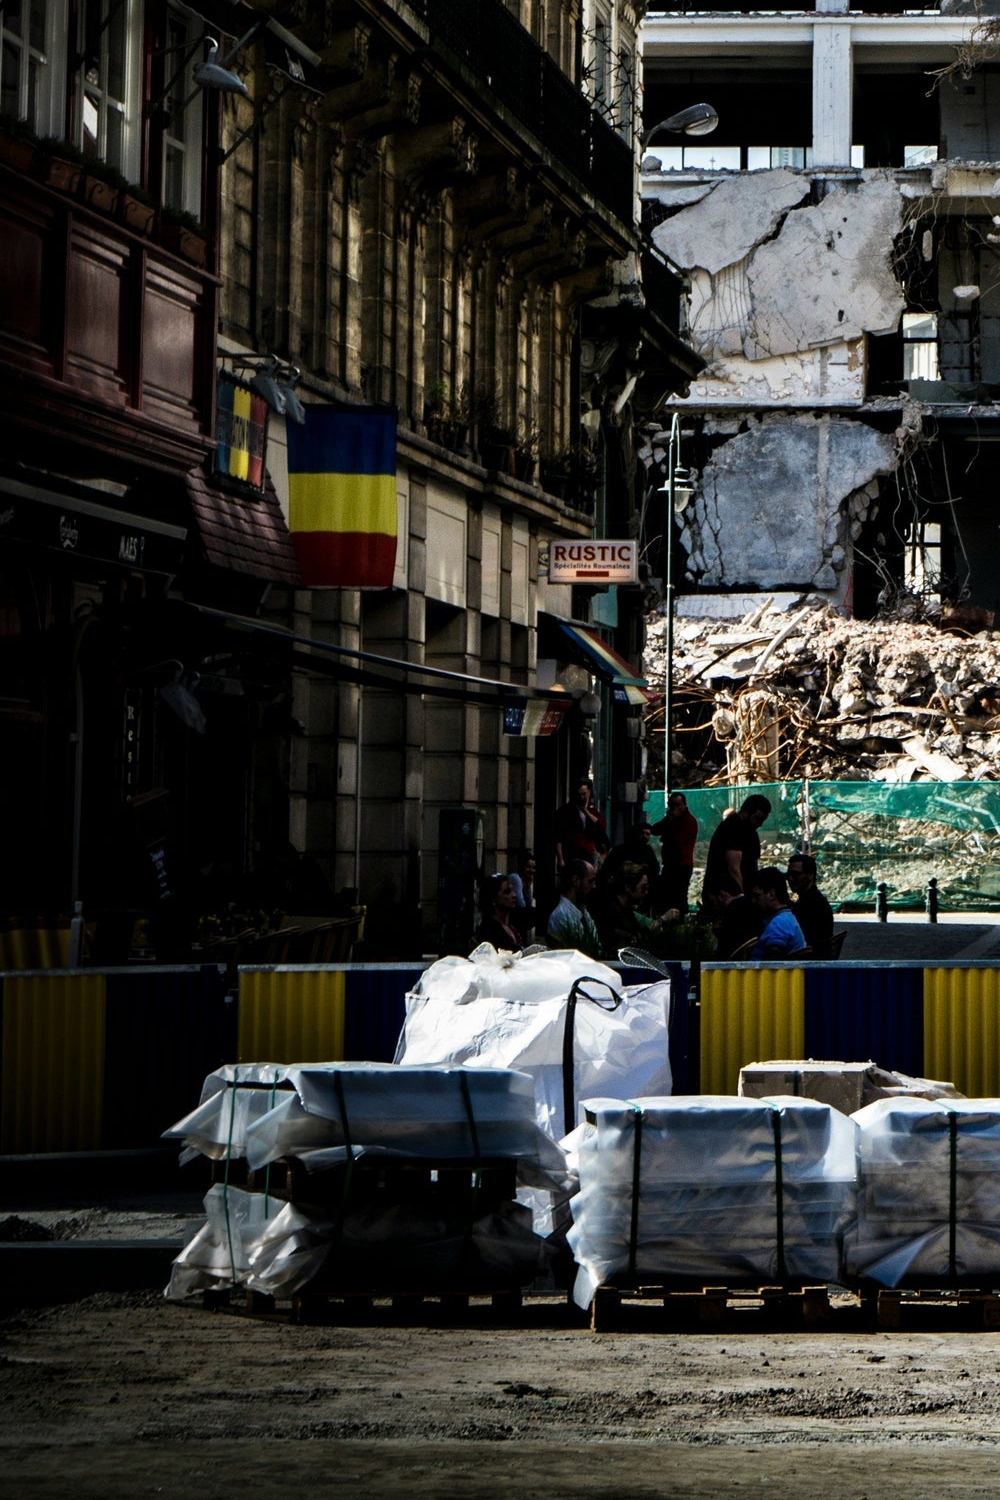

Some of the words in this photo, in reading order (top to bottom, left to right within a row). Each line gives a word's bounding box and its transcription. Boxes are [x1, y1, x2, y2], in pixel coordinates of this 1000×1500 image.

[554, 545, 631, 562] RUSTIC
[553, 562, 591, 570] Spécialités
[592, 562, 631, 570] Roumaines
